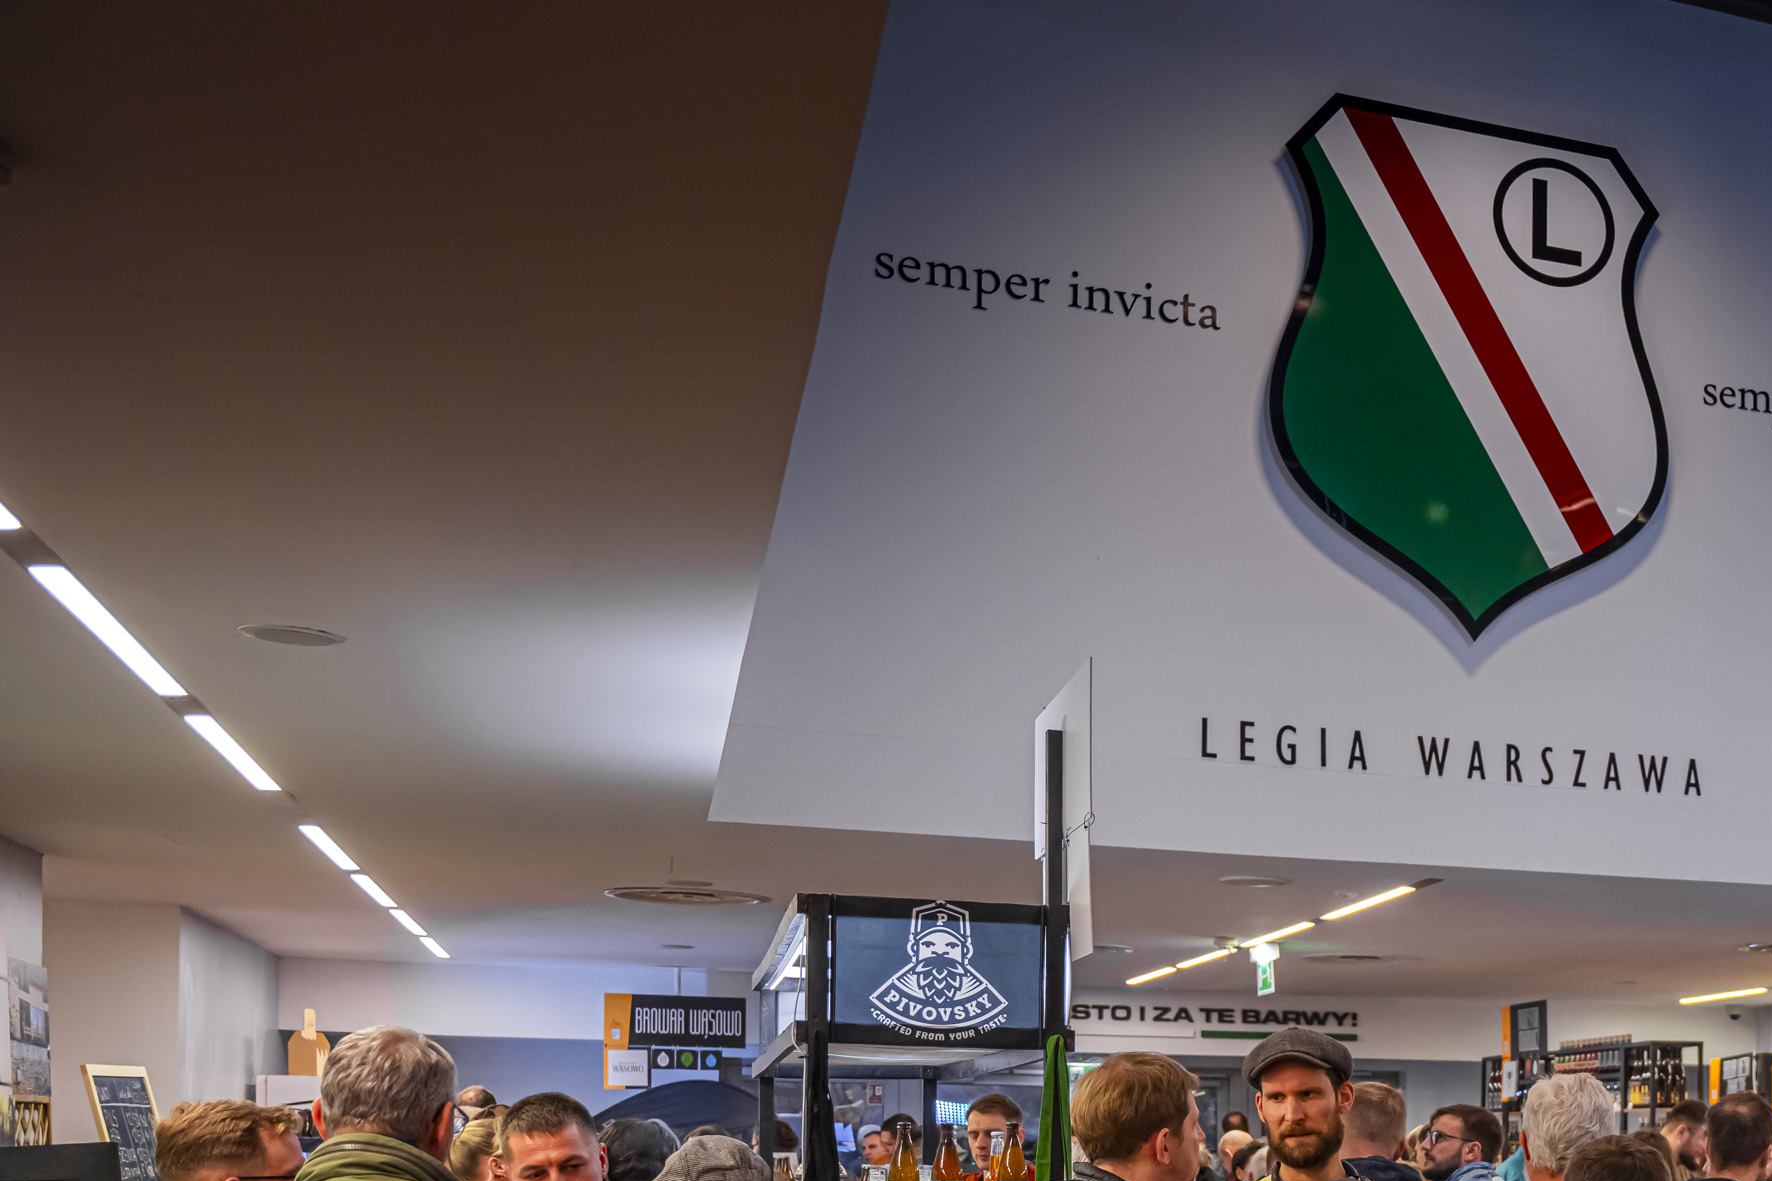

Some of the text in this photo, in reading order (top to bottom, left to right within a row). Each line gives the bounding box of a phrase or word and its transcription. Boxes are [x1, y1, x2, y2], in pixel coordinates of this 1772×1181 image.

[1532, 177, 1582, 267] L
[874, 251, 1221, 331] semper invicta
[1200, 717, 1702, 797] LEGIA WARSZAWA
[936, 913, 948, 926] P
[883, 989, 992, 1021] PIVOVSKY
[1139, 1006, 1146, 1021] I
[1153, 1006, 1194, 1023] ZA
[1200, 1008, 1235, 1024] TE
[1242, 1009, 1358, 1027] BARWY!
[635, 1007, 742, 1039] BROWAR WĄSOWO
[872, 1009, 1006, 1041] CRAFTED FROM YOUR TASTE
